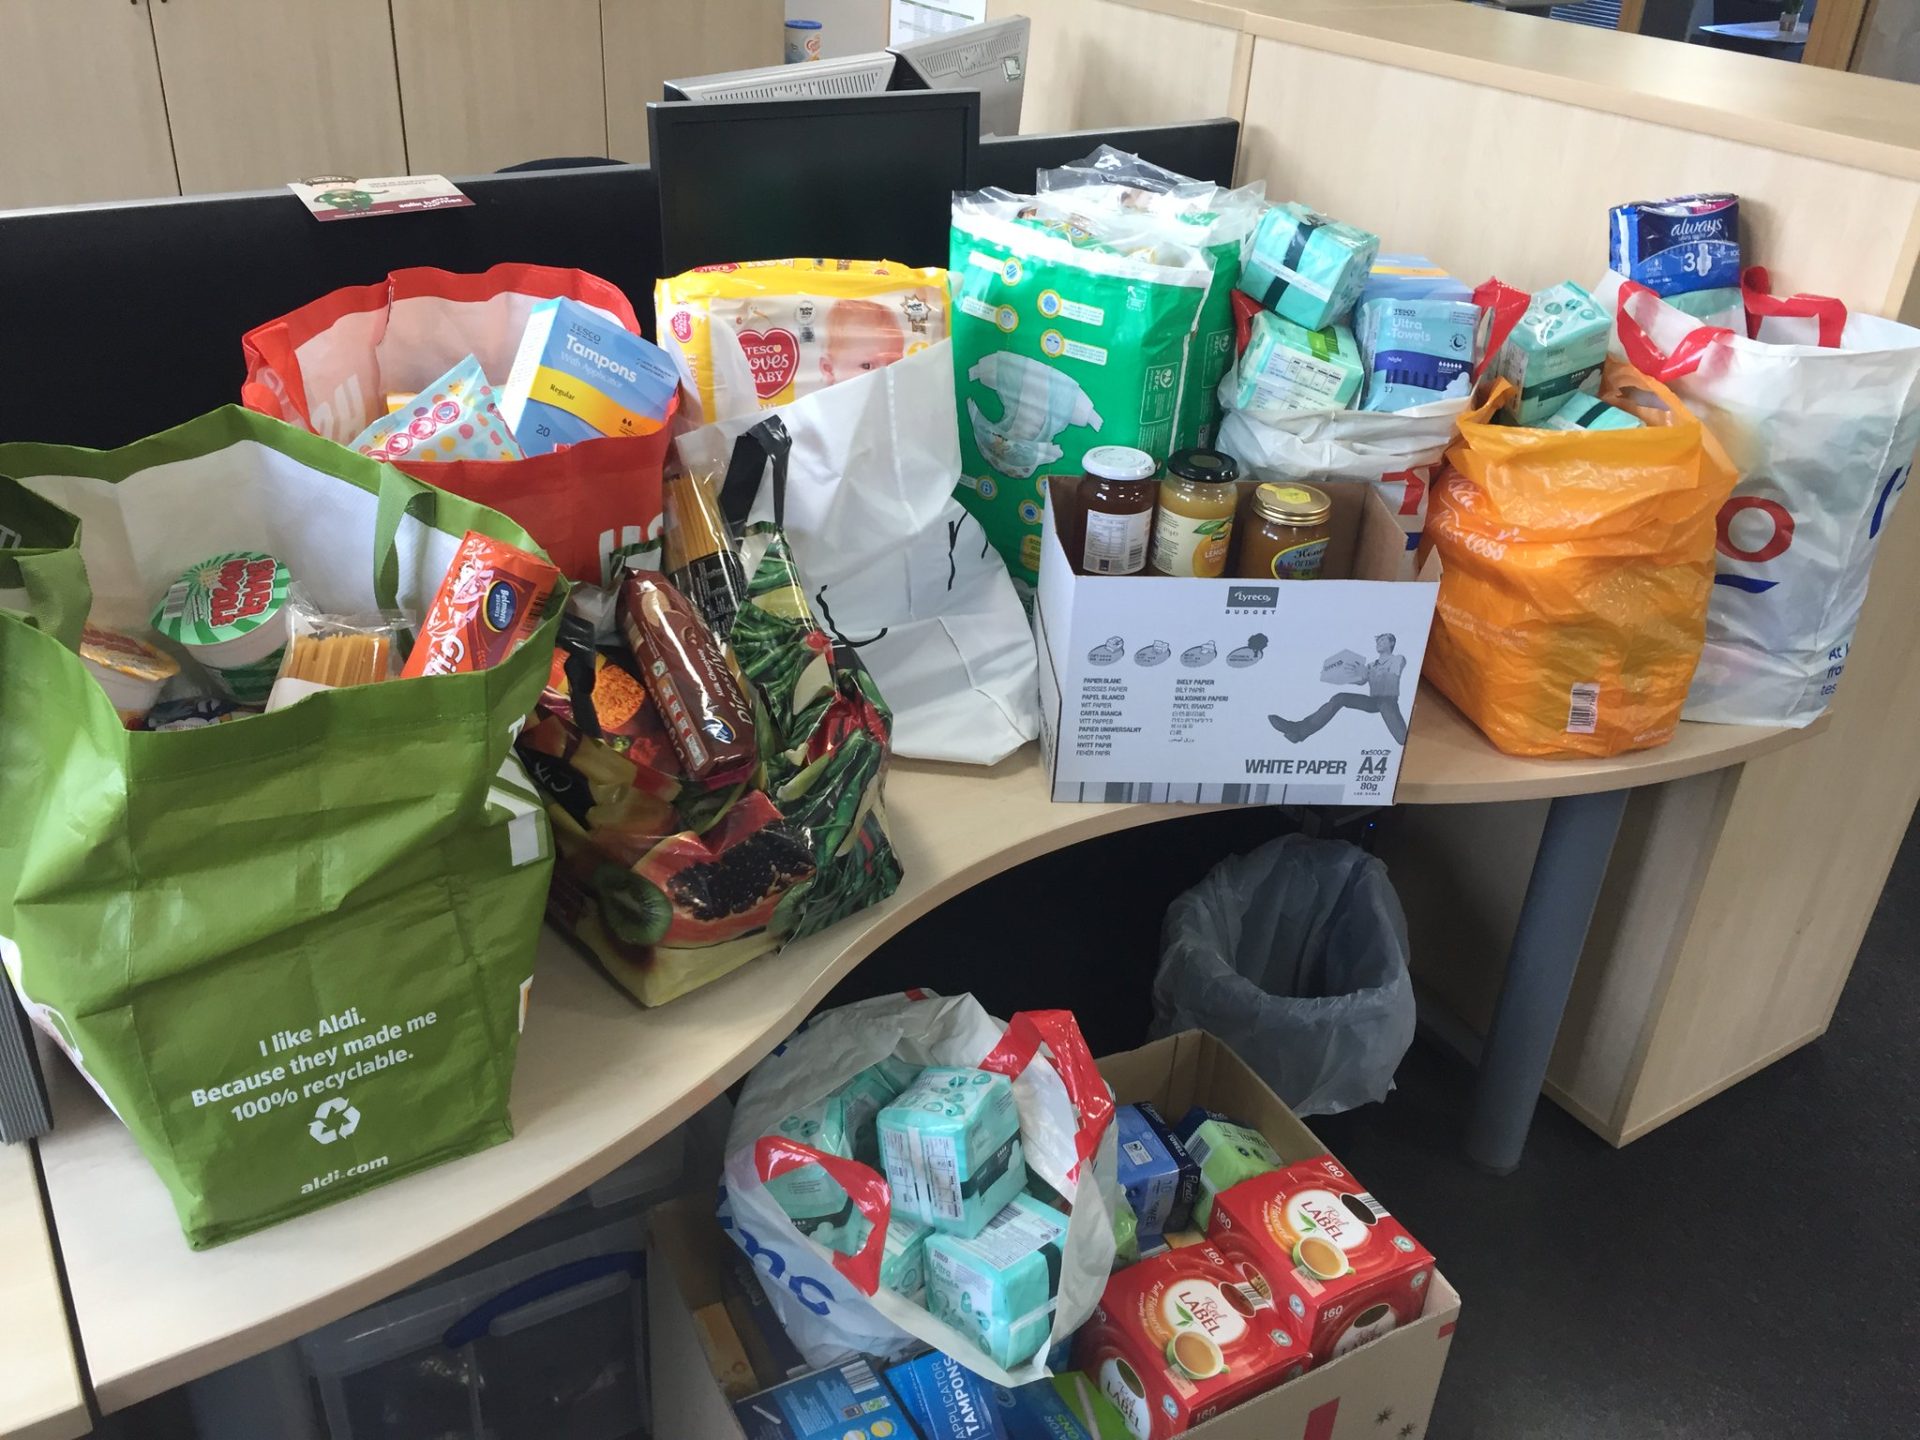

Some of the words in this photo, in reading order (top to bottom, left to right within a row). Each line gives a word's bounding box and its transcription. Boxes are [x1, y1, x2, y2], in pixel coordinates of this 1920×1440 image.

[1670, 218, 1723, 238] always
[571, 322, 601, 343] TESCO
[1392, 318, 1423, 330] Ultra
[1391, 328, 1431, 341] Towels
[566, 334, 638, 383] Tampons
[744, 344, 782, 355] TESCO
[751, 353, 789, 370] oves
[549, 383, 576, 401] Regular
[535, 423, 551, 438] 20
[499, 588, 510, 623] Belmont
[1828, 648, 1843, 661] At
[1826, 664, 1845, 679] fro
[1820, 683, 1837, 697] tes
[1245, 759, 1294, 774] WHITE
[1296, 760, 1347, 775] PAPER
[1358, 756, 1388, 774] A4
[1360, 782, 1378, 792] 80g
[259, 1039, 268, 1057] I
[271, 1028, 313, 1053] like
[318, 1007, 367, 1037] Aldi.
[191, 1065, 286, 1107] Because
[289, 1046, 338, 1076] they
[343, 1023, 403, 1056] made
[406, 1011, 438, 1033] me
[231, 1088, 299, 1122] 100%
[302, 1048, 415, 1099] recyclable.
[1168, 1133, 1187, 1158] TOWELS
[300, 1155, 390, 1195] aldi.com
[1320, 1160, 1344, 1178] 160
[1215, 1207, 1233, 1230] 160
[1300, 1201, 1344, 1242] LABEL
[1326, 1205, 1350, 1227] Red
[1203, 1247, 1225, 1266] 160
[932, 1259, 952, 1278] Ultra
[1178, 1291, 1221, 1337] LABEL
[1204, 1296, 1228, 1319] Red
[1321, 1305, 1344, 1321] 160
[930, 1360, 967, 1440] APPLICATOR
[943, 1356, 980, 1437] TAMPONS
[1106, 1381, 1142, 1433] LABEL
